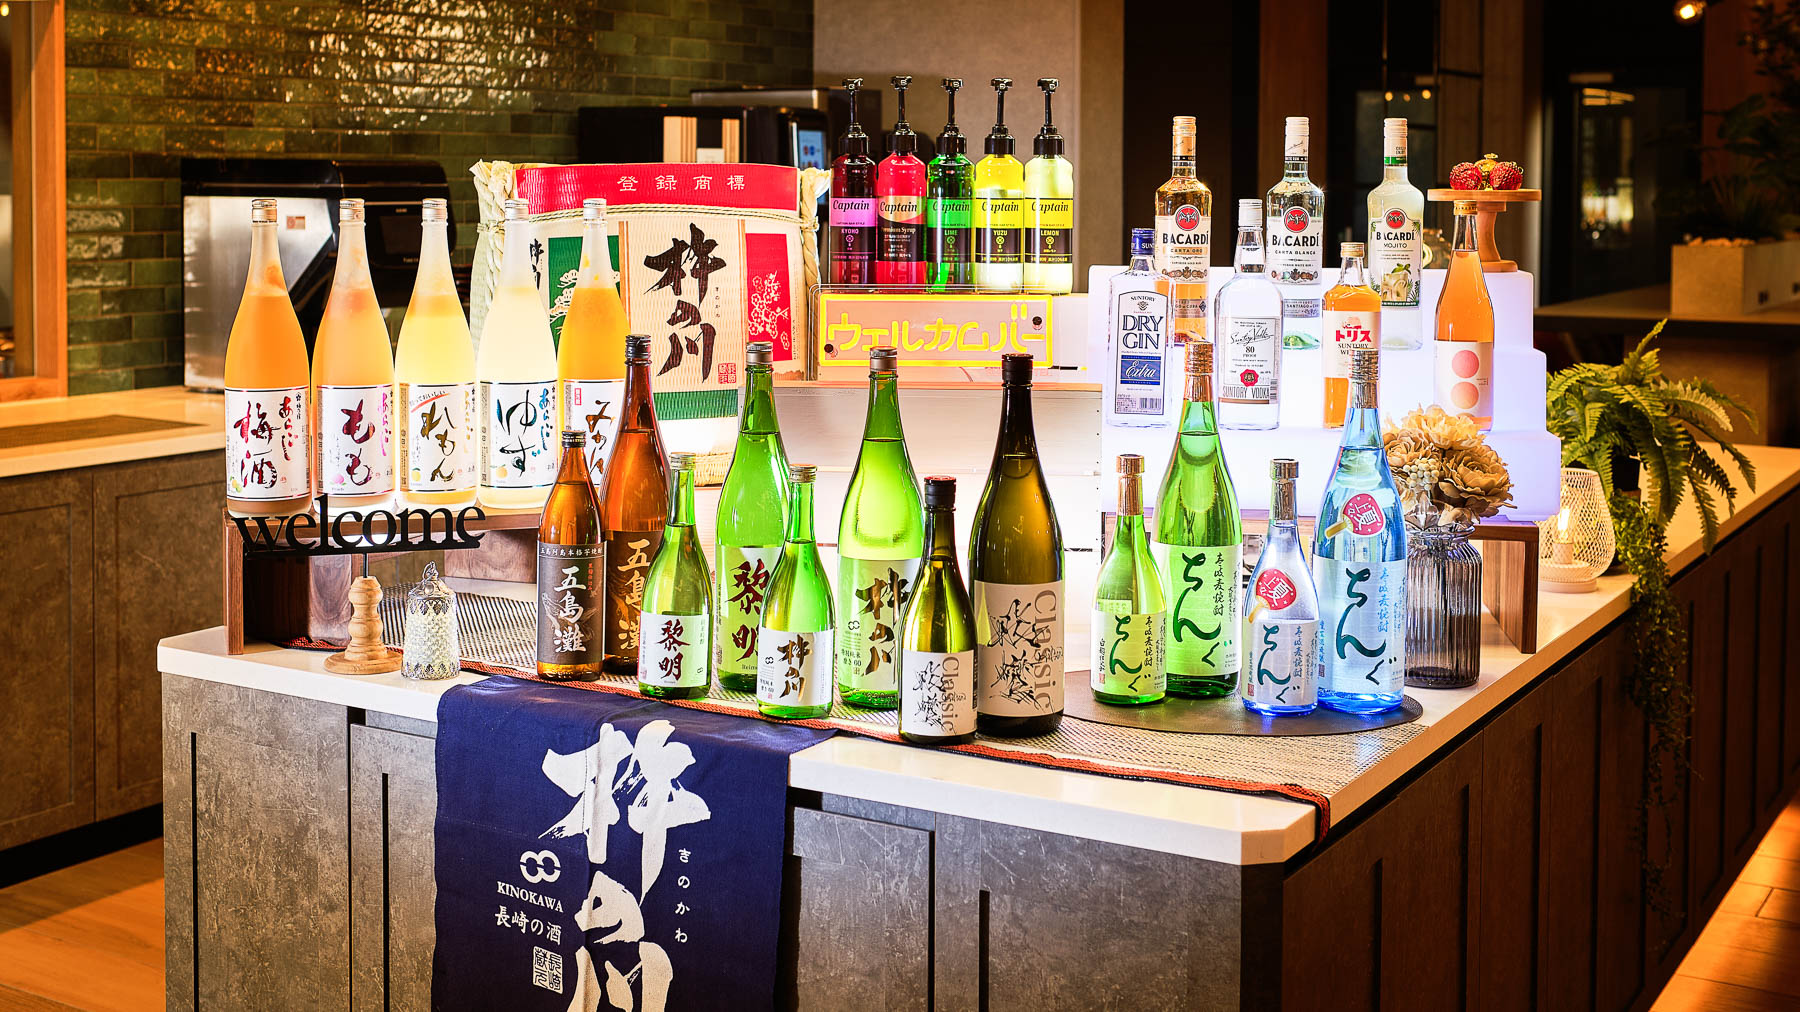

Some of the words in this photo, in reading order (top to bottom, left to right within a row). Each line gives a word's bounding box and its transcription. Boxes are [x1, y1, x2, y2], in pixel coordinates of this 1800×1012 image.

[616, 173, 746, 192] 登録商標
[832, 199, 870, 212] Captain
[879, 201, 918, 215] Captain
[901, 226, 917, 235] Syrup
[993, 229, 1008, 237] YUZU
[1162, 230, 1209, 245] BACARDÍ
[642, 221, 727, 384] 杵の川
[827, 302, 1046, 353] ウェルカムバー
[1122, 314, 1164, 332] DRY
[1122, 332, 1161, 350] GIN
[1335, 329, 1372, 343] トリス
[1125, 359, 1157, 380] Extra
[1222, 385, 1248, 399] SUNTORY
[1251, 386, 1270, 400] VODKA
[233, 400, 282, 490] 梅酒
[340, 398, 376, 486] もも
[420, 401, 457, 483] れもん
[495, 388, 542, 478] ゆず
[231, 494, 487, 552] welcome
[1353, 503, 1381, 532] 夏
[553, 565, 587, 654] 五島灘
[1172, 552, 1233, 668] ちんぐ
[1267, 577, 1294, 606] 夏
[656, 618, 691, 681] 黎明
[1034, 589, 1058, 709] Classic
[1109, 614, 1152, 692] ちんぐ
[1335, 567, 1398, 686] ちんぐ
[776, 633, 813, 702] 杵の川
[1256, 623, 1301, 704] ちんぐ
[941, 656, 960, 731] Classic
[496, 880, 564, 913] KINOKAWA
[674, 847, 692, 944] きのかわ
[494, 904, 563, 946] 長崎の酒
